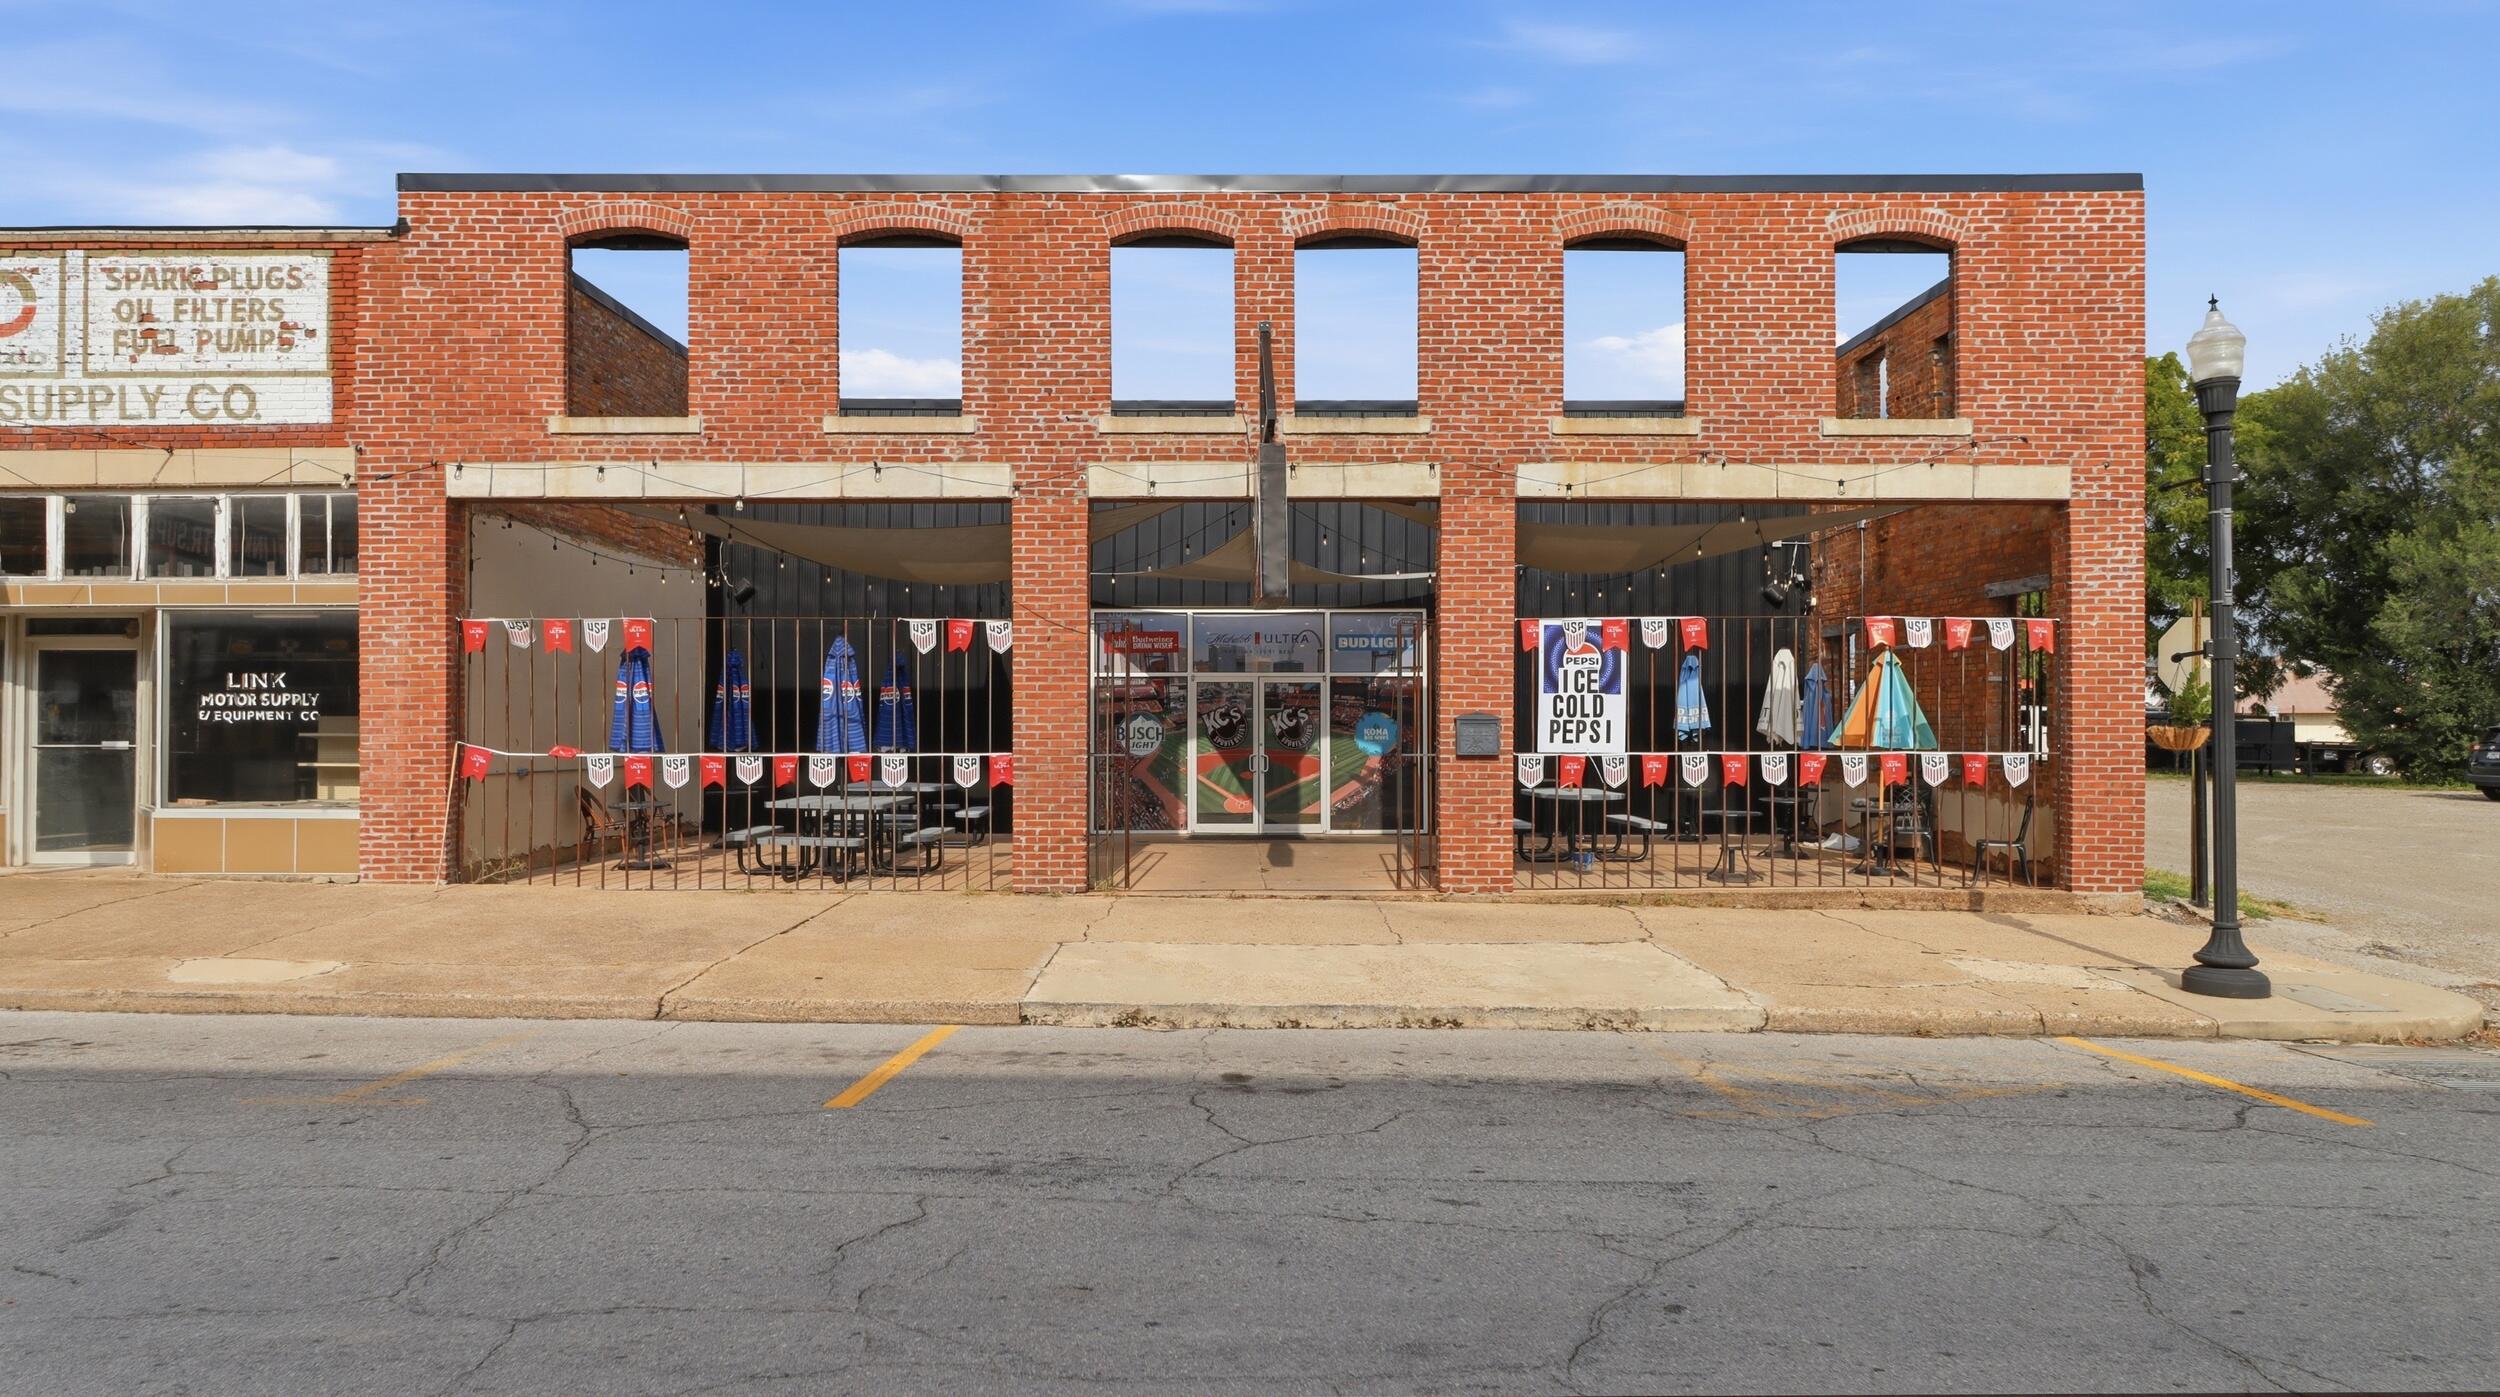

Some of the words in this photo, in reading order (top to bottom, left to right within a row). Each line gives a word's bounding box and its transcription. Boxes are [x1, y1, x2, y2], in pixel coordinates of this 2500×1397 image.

[104, 266, 203, 291] SPARK
[212, 266, 304, 290] PLUGS
[115, 298, 160, 322] OIL
[174, 298, 286, 322] FILTERS
[113, 328, 180, 353] FUEL
[196, 328, 295, 354] PUMPS
[0, 384, 166, 421] SUPPLY
[186, 383, 262, 421] CO.
[509, 621, 529, 631] USA
[587, 622, 606, 633] USA
[912, 623, 933, 635] USA
[989, 622, 1009, 634] USA
[1563, 621, 1584, 633] USA
[1644, 621, 1663, 632] USA
[1264, 633, 1310, 644] ULTRA
[1338, 637, 1369, 648] BUD
[1566, 657, 1600, 666] PEPSI
[226, 672, 287, 690] LINK
[1563, 669, 1599, 694] ICE
[201, 693, 257, 706] MOTOR
[261, 693, 320, 706] SUPPLY
[1552, 694, 1605, 718] COLD
[214, 711, 294, 724] EQUIPMENT
[1116, 726, 1165, 741] BUSCH
[1549, 719, 1612, 743] PEPSI
[1131, 741, 1155, 749] IGHT
[591, 758, 610, 769] USA
[666, 758, 686, 770] USA
[812, 758, 832, 770] USA
[884, 758, 905, 770] USA
[957, 758, 977, 770] USA
[1521, 757, 1541, 769] USA
[1605, 757, 1625, 769] USA
[1685, 756, 1705, 768] USA
[1764, 756, 1784, 768] USA
[1844, 757, 1864, 768] USA
[1925, 756, 1945, 768] USA
[2006, 757, 2026, 768] USA
